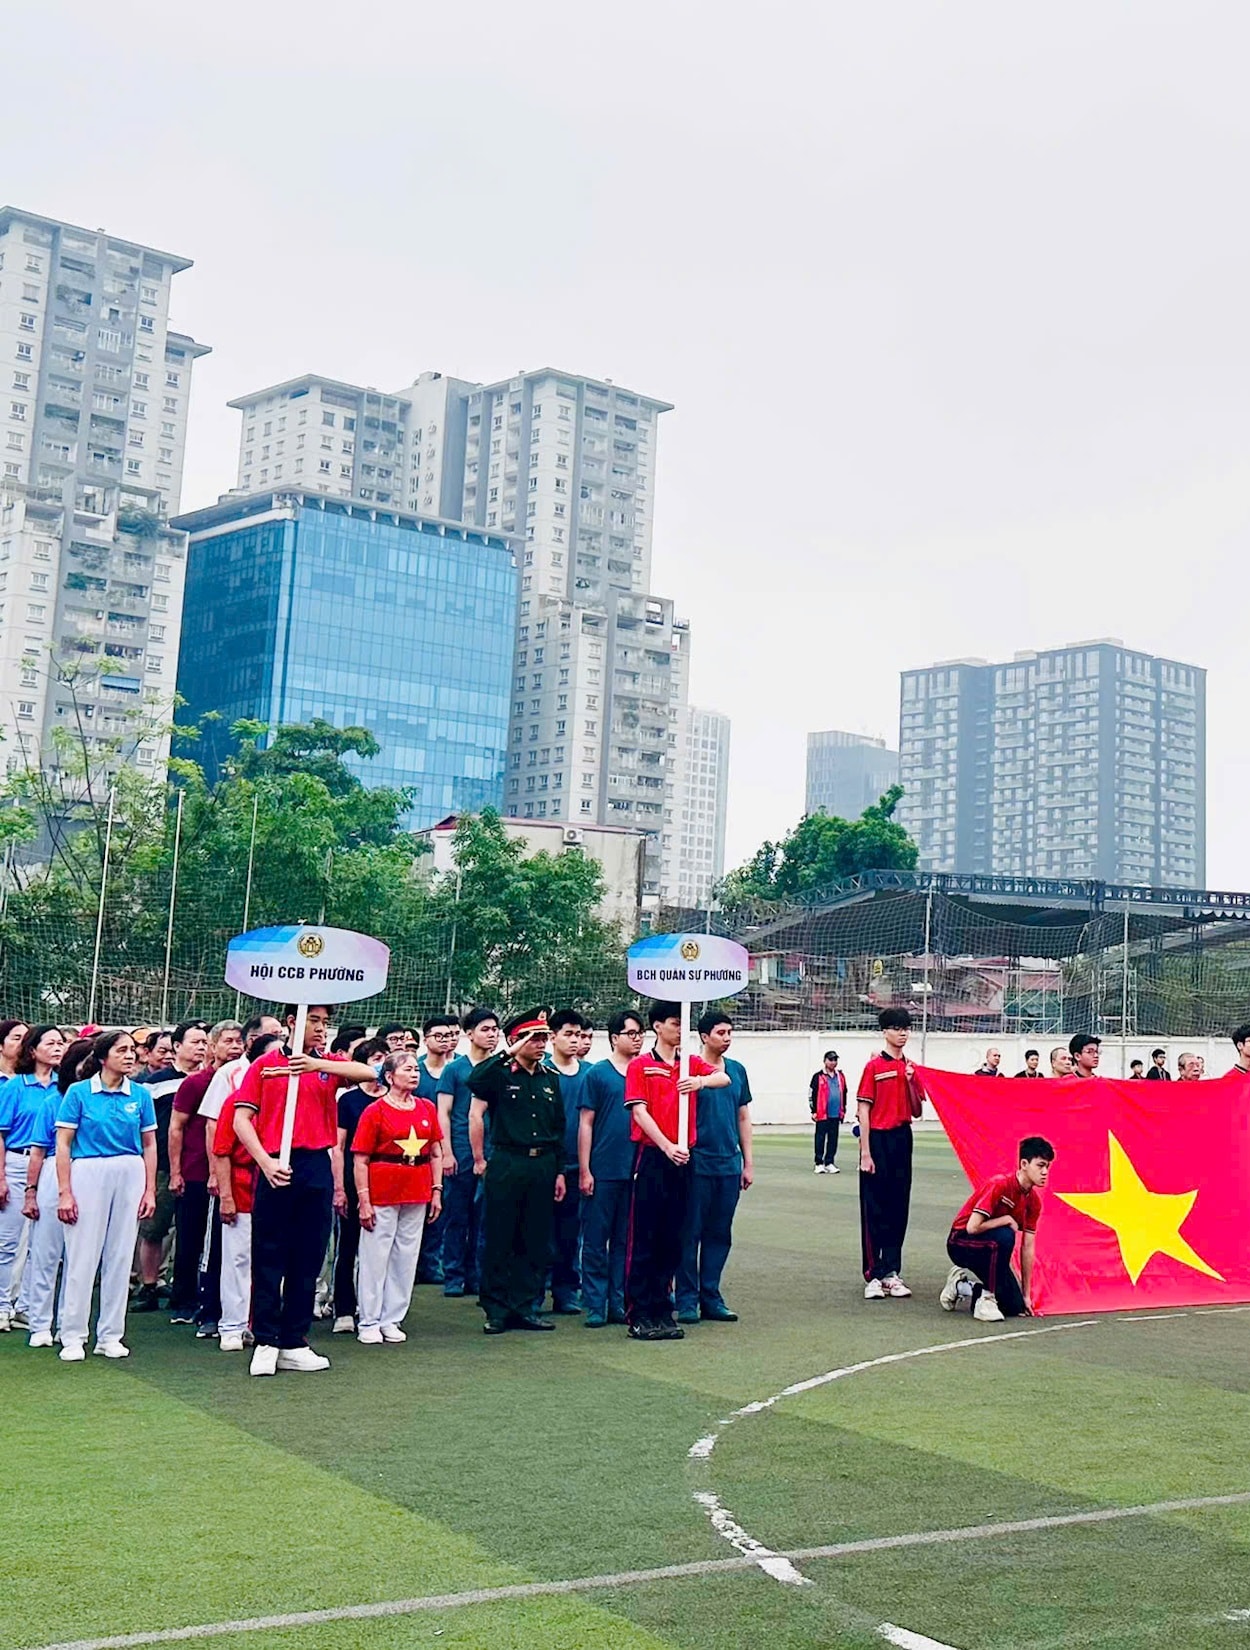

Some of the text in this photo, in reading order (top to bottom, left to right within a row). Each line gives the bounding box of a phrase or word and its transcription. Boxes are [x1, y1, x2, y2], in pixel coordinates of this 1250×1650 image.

[250, 963, 364, 981] HỘI CCB PHƯỜNG
[636, 967, 742, 983] BCH QUÂN SỰ PHƯỜNG
